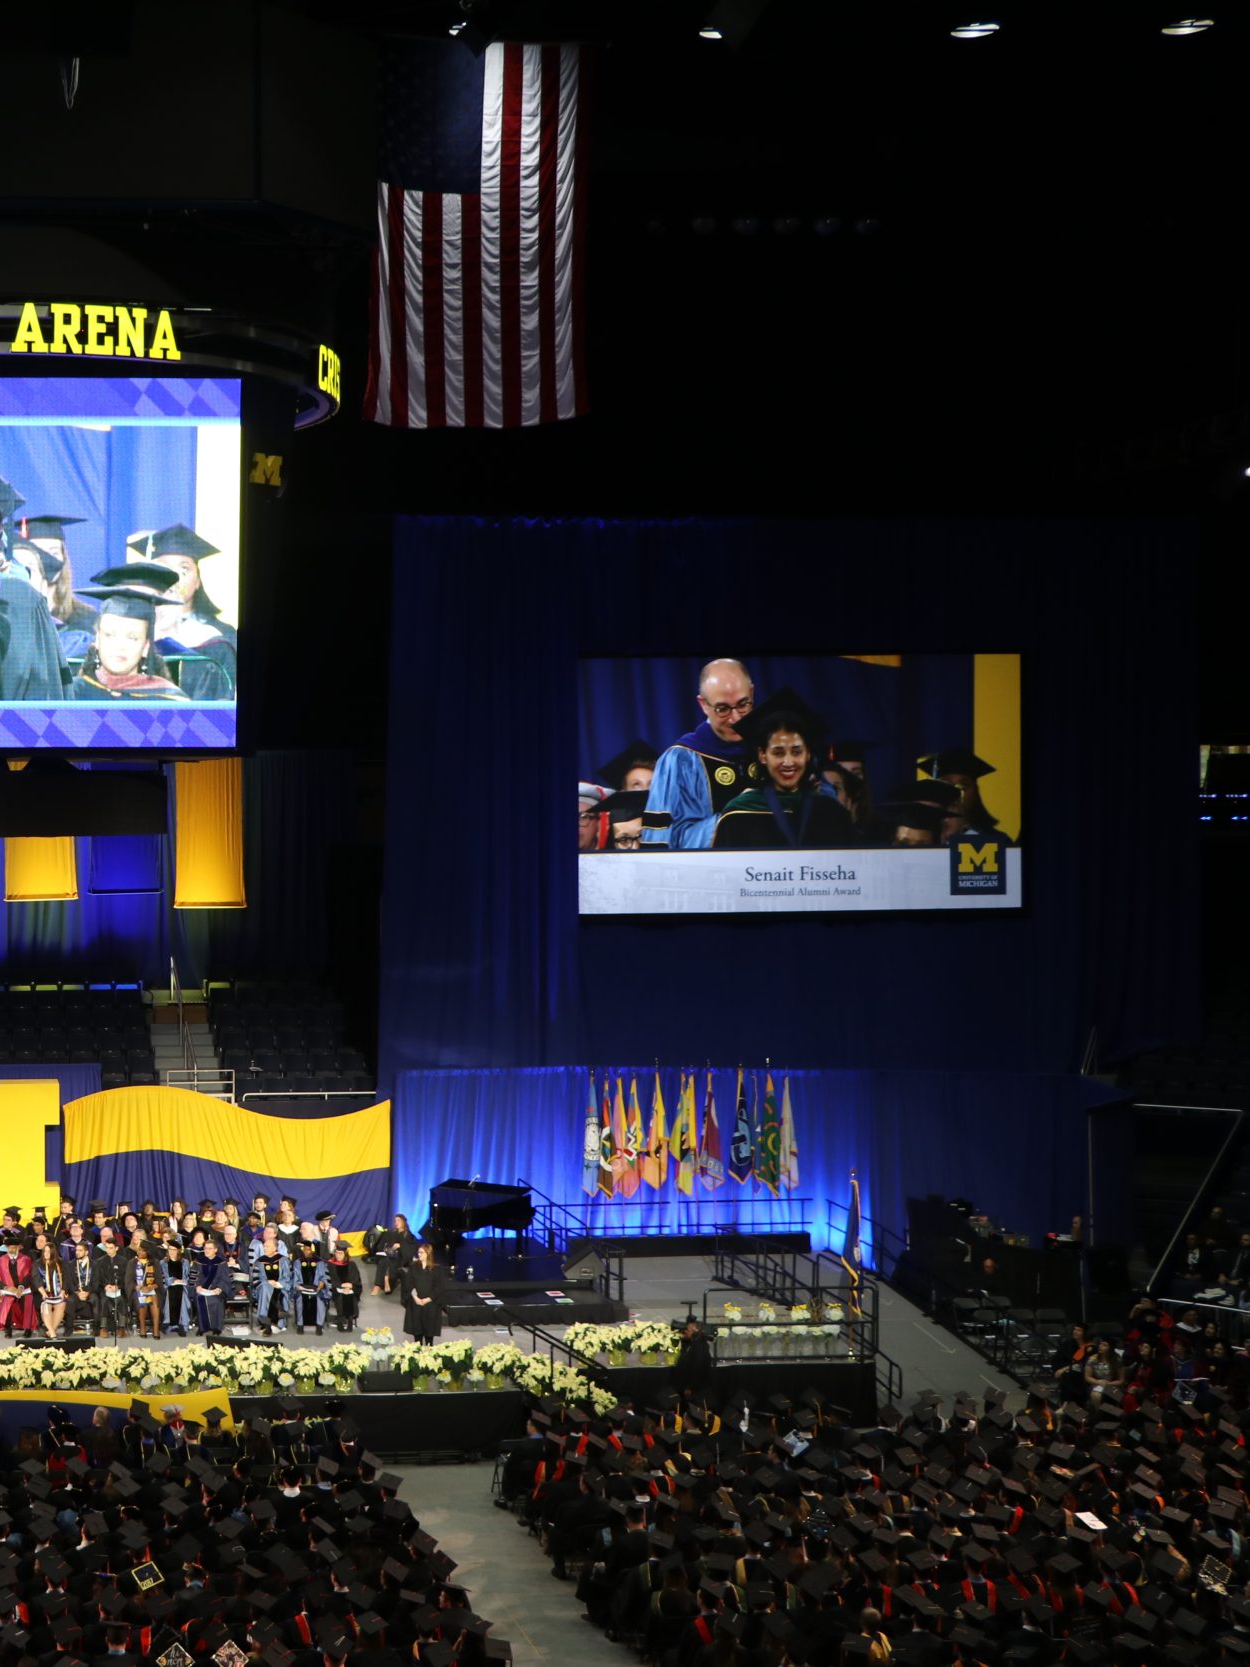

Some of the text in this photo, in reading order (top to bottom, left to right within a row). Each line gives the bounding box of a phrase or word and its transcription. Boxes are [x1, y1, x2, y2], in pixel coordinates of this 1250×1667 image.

[11, 302, 182, 360] ARENA
[250, 452, 283, 486] M
[958, 843, 998, 872] M
[745, 865, 856, 881] Senait Fisseha
[740, 886, 862, 897] Bicentennial Alumni Award
